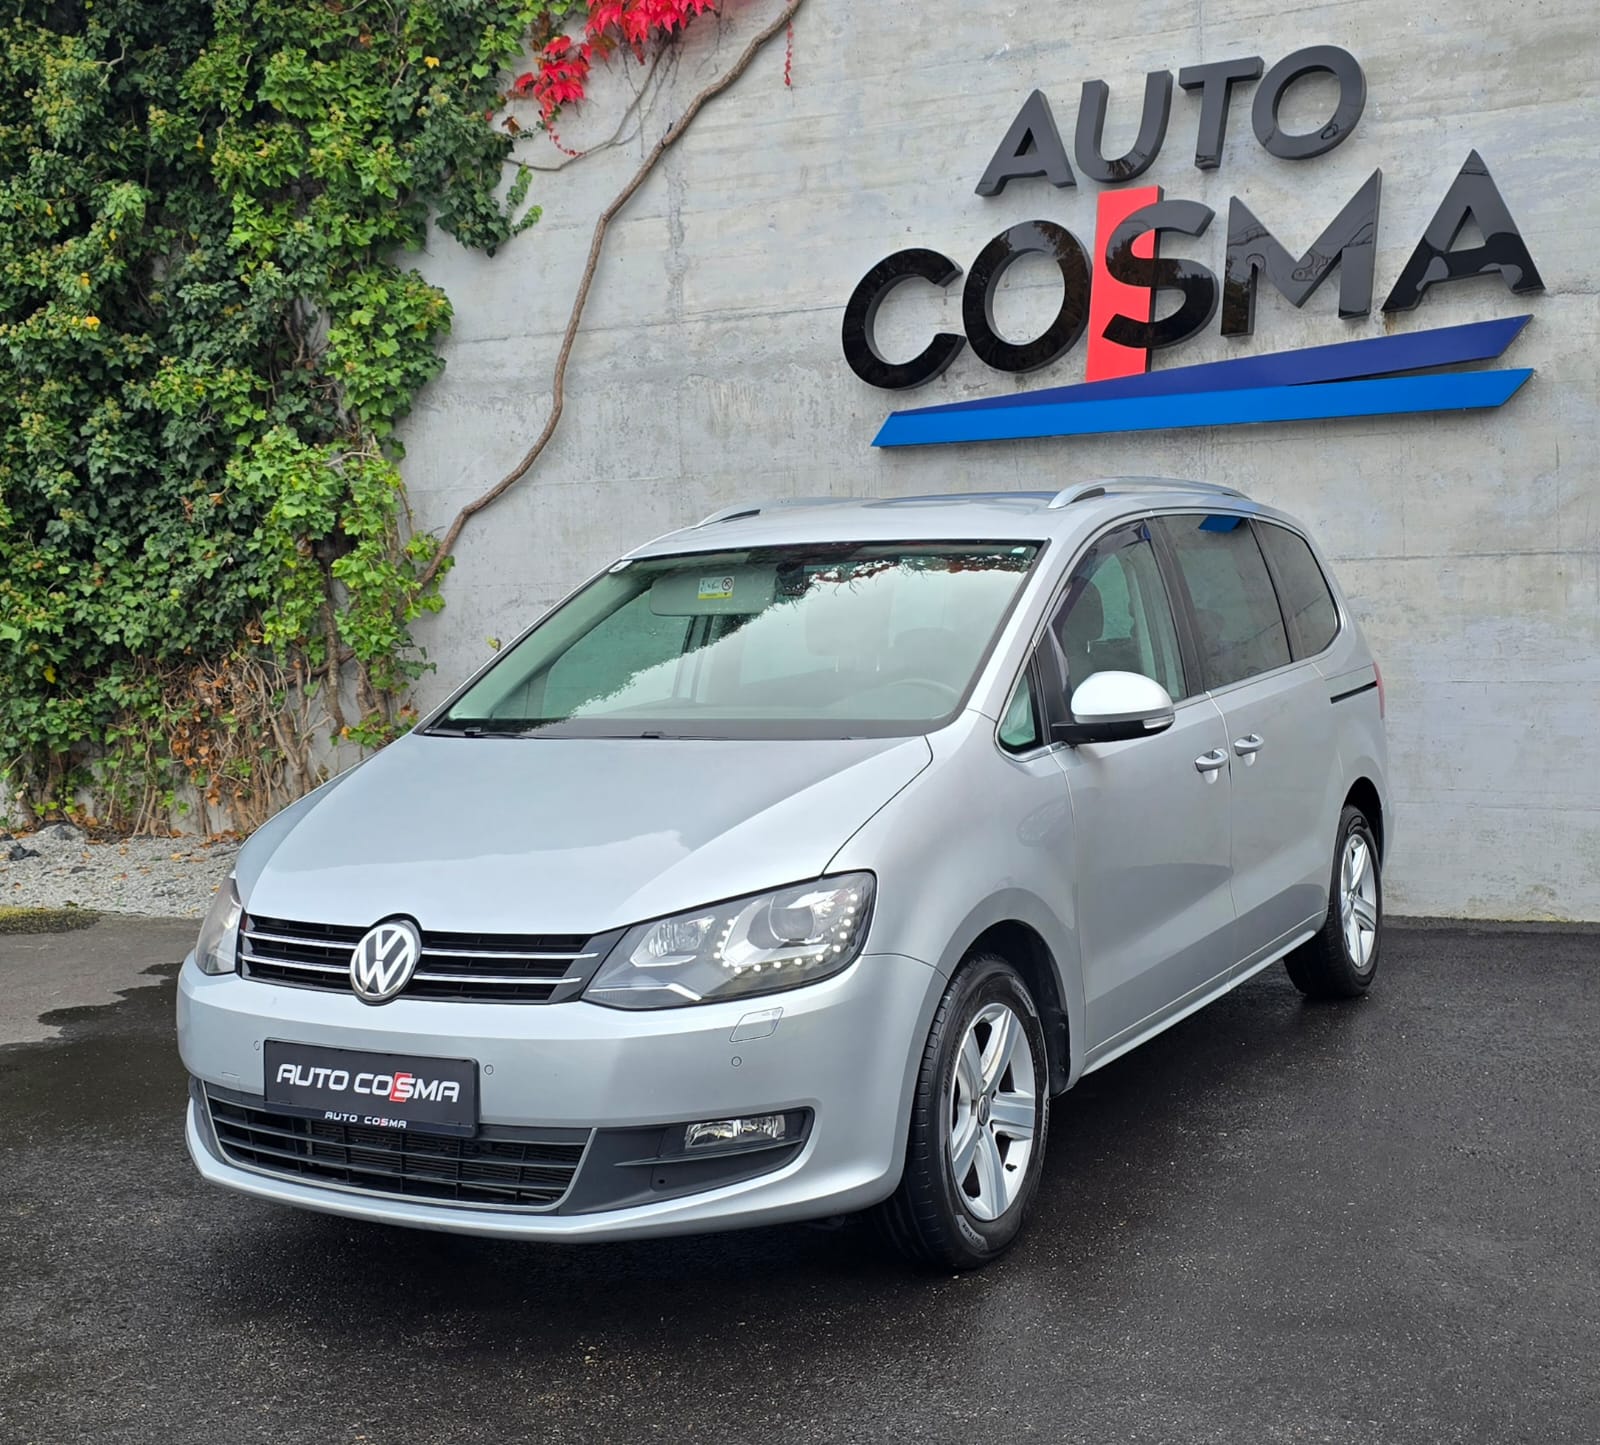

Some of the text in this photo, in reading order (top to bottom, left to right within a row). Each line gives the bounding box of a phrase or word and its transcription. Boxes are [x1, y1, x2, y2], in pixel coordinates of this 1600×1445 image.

[974, 44, 1367, 198] AUTO
[842, 148, 1546, 390] COSMA
[350, 923, 417, 999] VW
[276, 1063, 460, 1103] AUTO COSMA
[324, 1110, 407, 1129] AUTO COSMA
